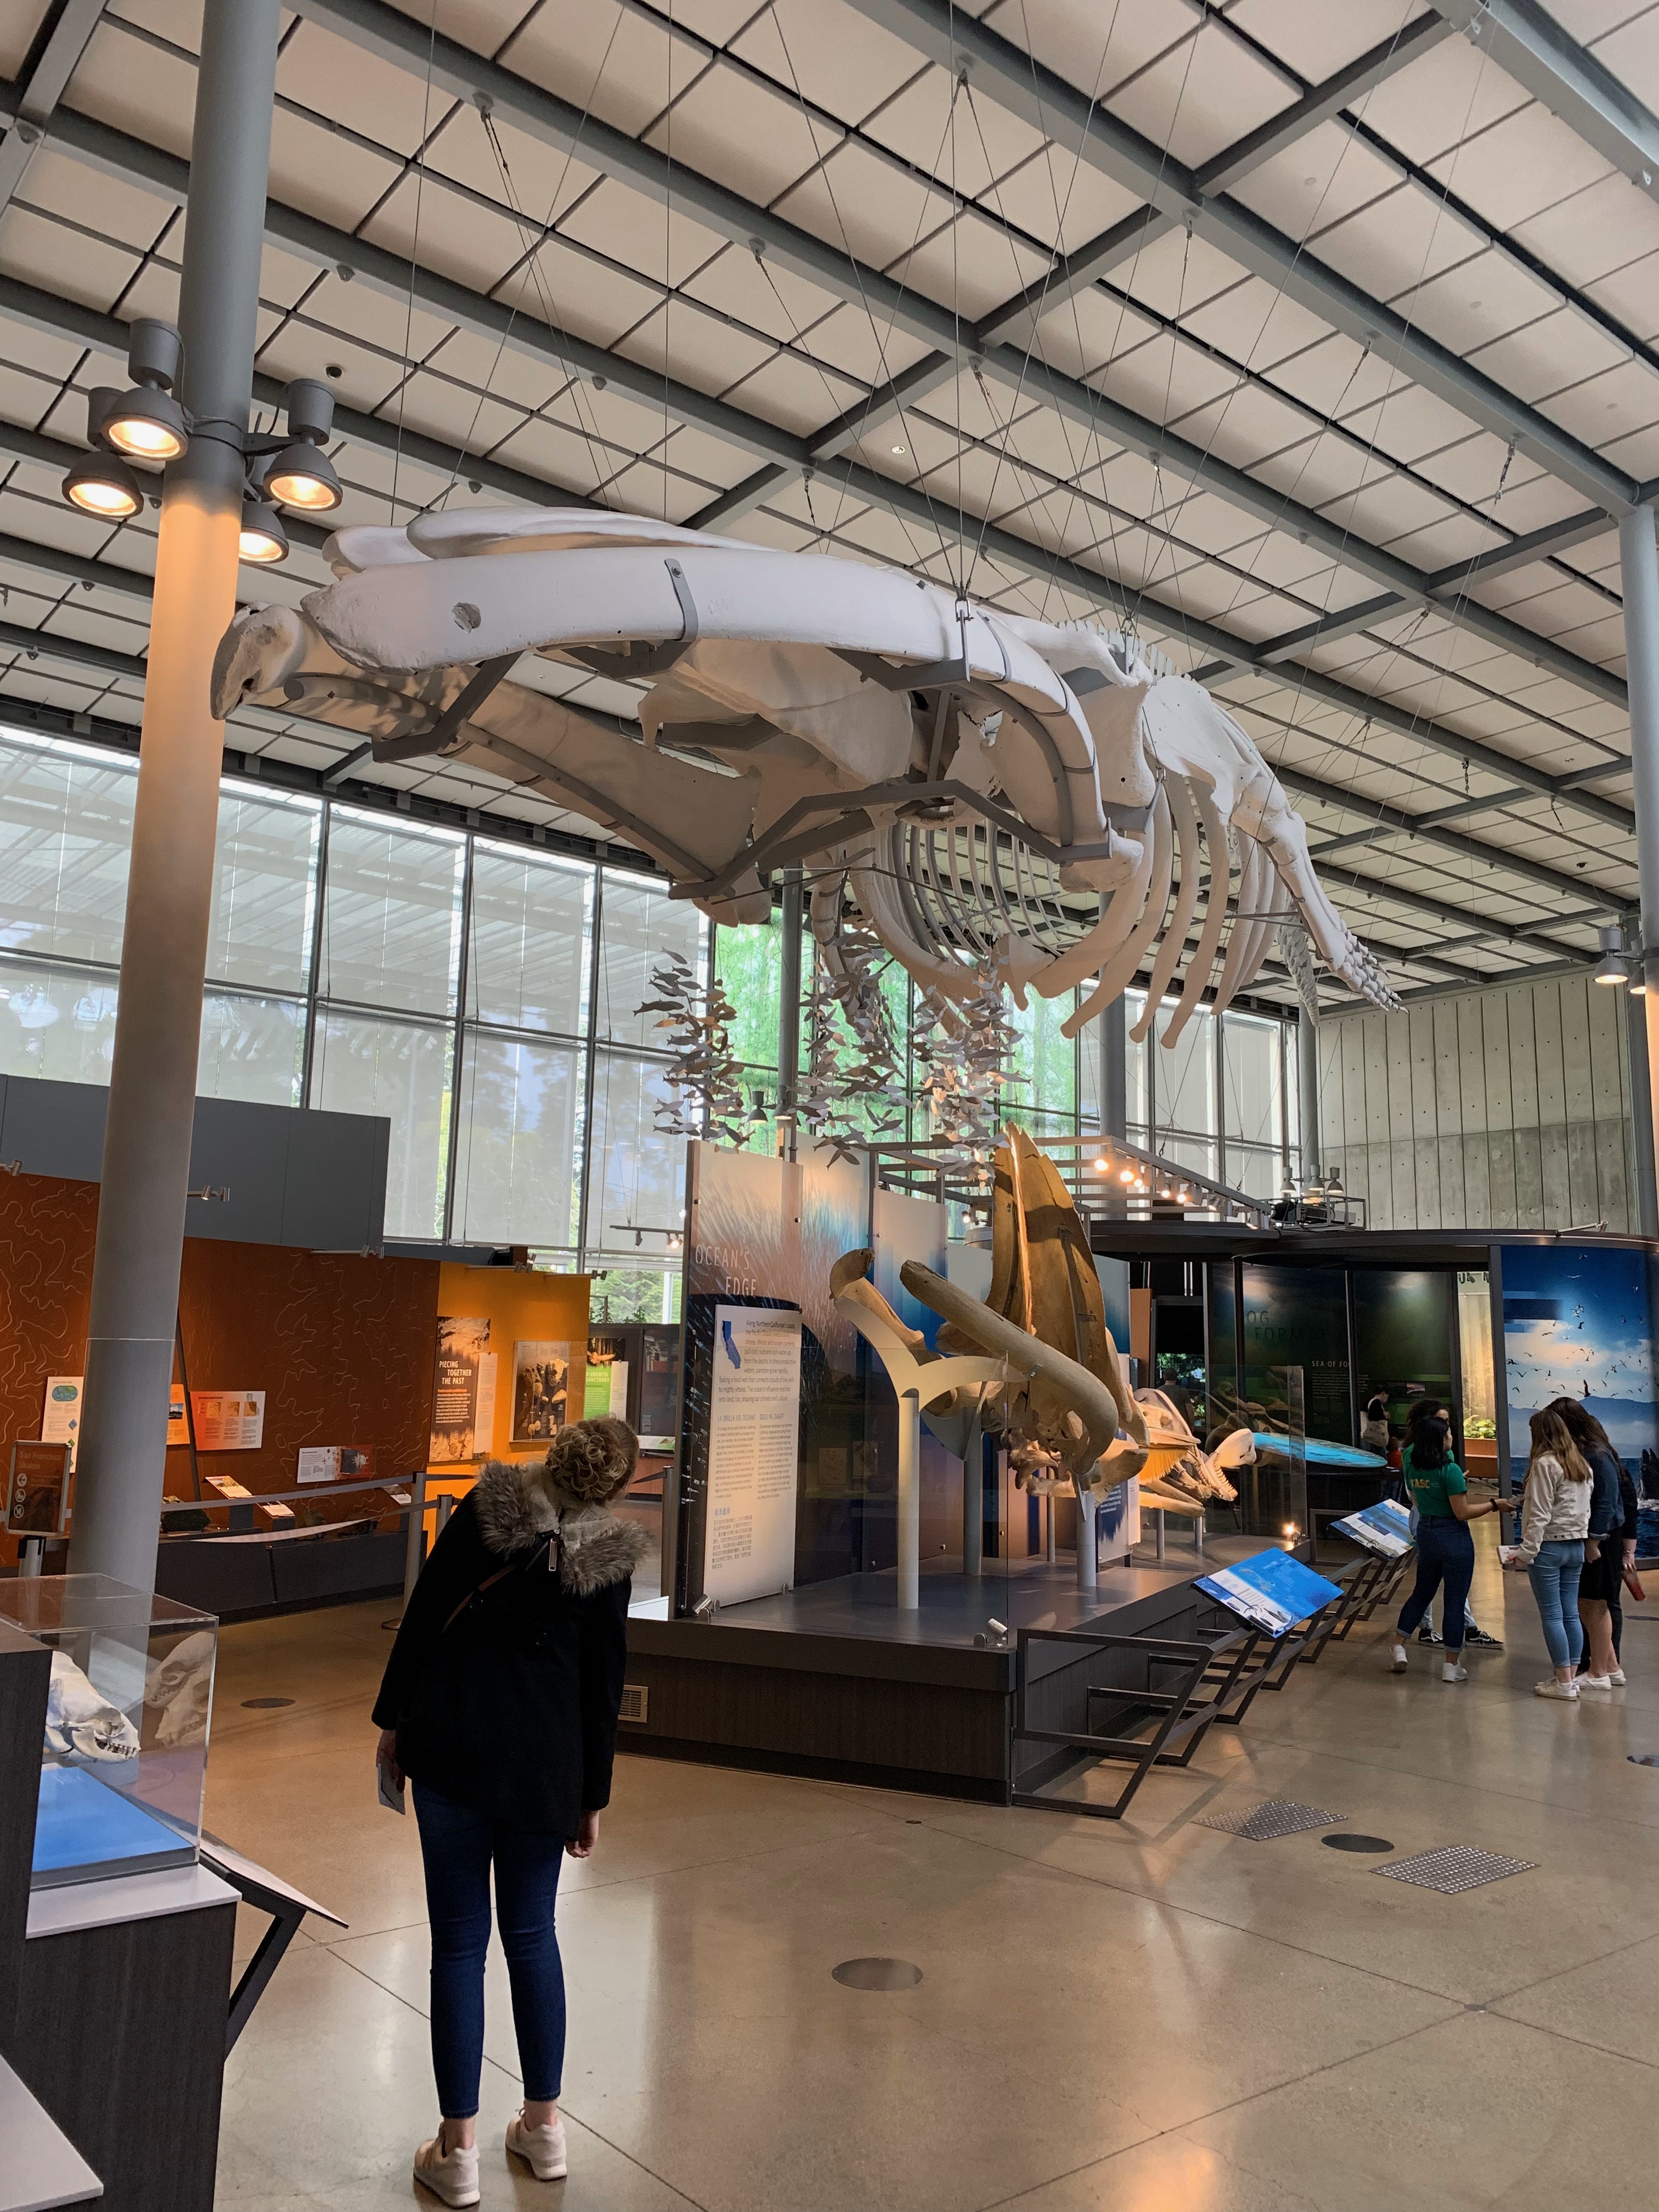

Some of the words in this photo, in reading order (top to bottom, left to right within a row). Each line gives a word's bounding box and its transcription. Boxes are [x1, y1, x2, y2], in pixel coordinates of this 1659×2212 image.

[696, 1244, 749, 1270] OCEAN'S
[725, 1276, 757, 1296] EDGE
[1247, 1310, 1269, 1325] OG
